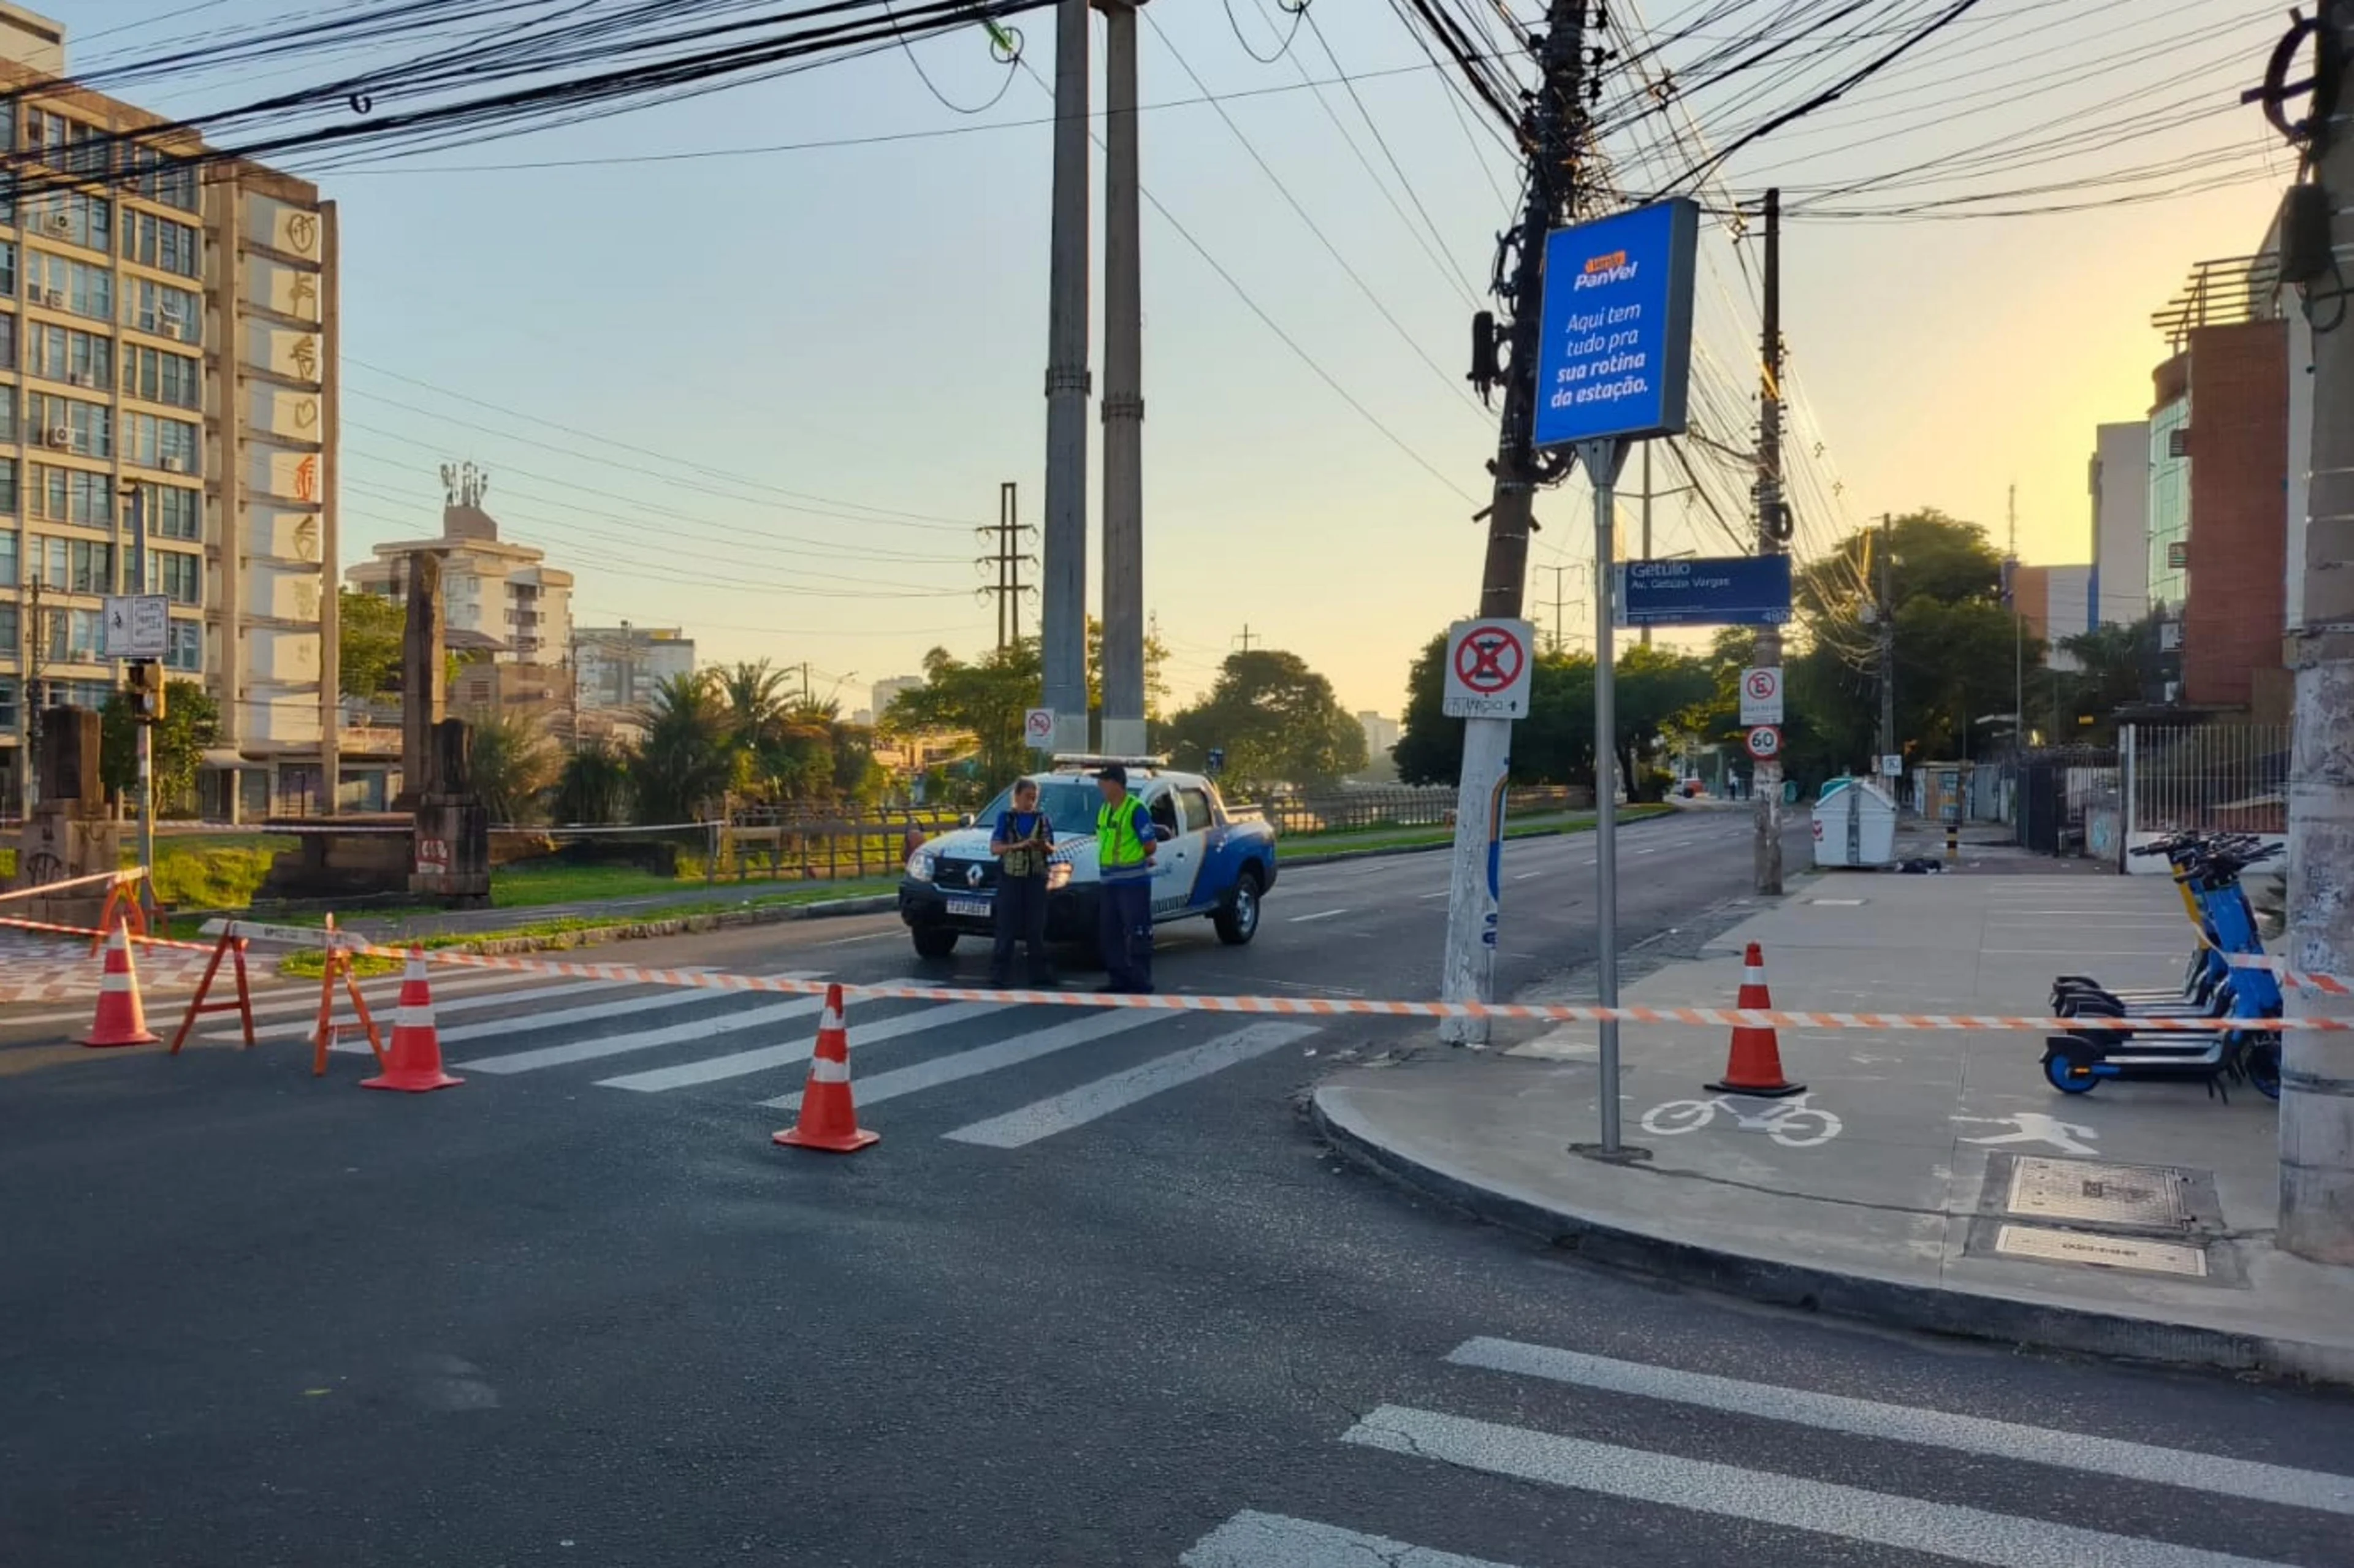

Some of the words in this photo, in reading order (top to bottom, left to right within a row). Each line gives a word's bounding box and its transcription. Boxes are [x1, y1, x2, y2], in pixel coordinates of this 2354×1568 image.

[1565, 305, 1605, 334] Aqui
[1608, 303, 1641, 324] tem
[1567, 333, 1605, 357] tudo
[1607, 329, 1639, 354] pra
[1557, 363, 1588, 383] sua
[1590, 351, 1646, 376] rotina
[1551, 388, 1573, 408] da
[1576, 375, 1649, 403] estação.
[1752, 732, 1775, 748] 60
